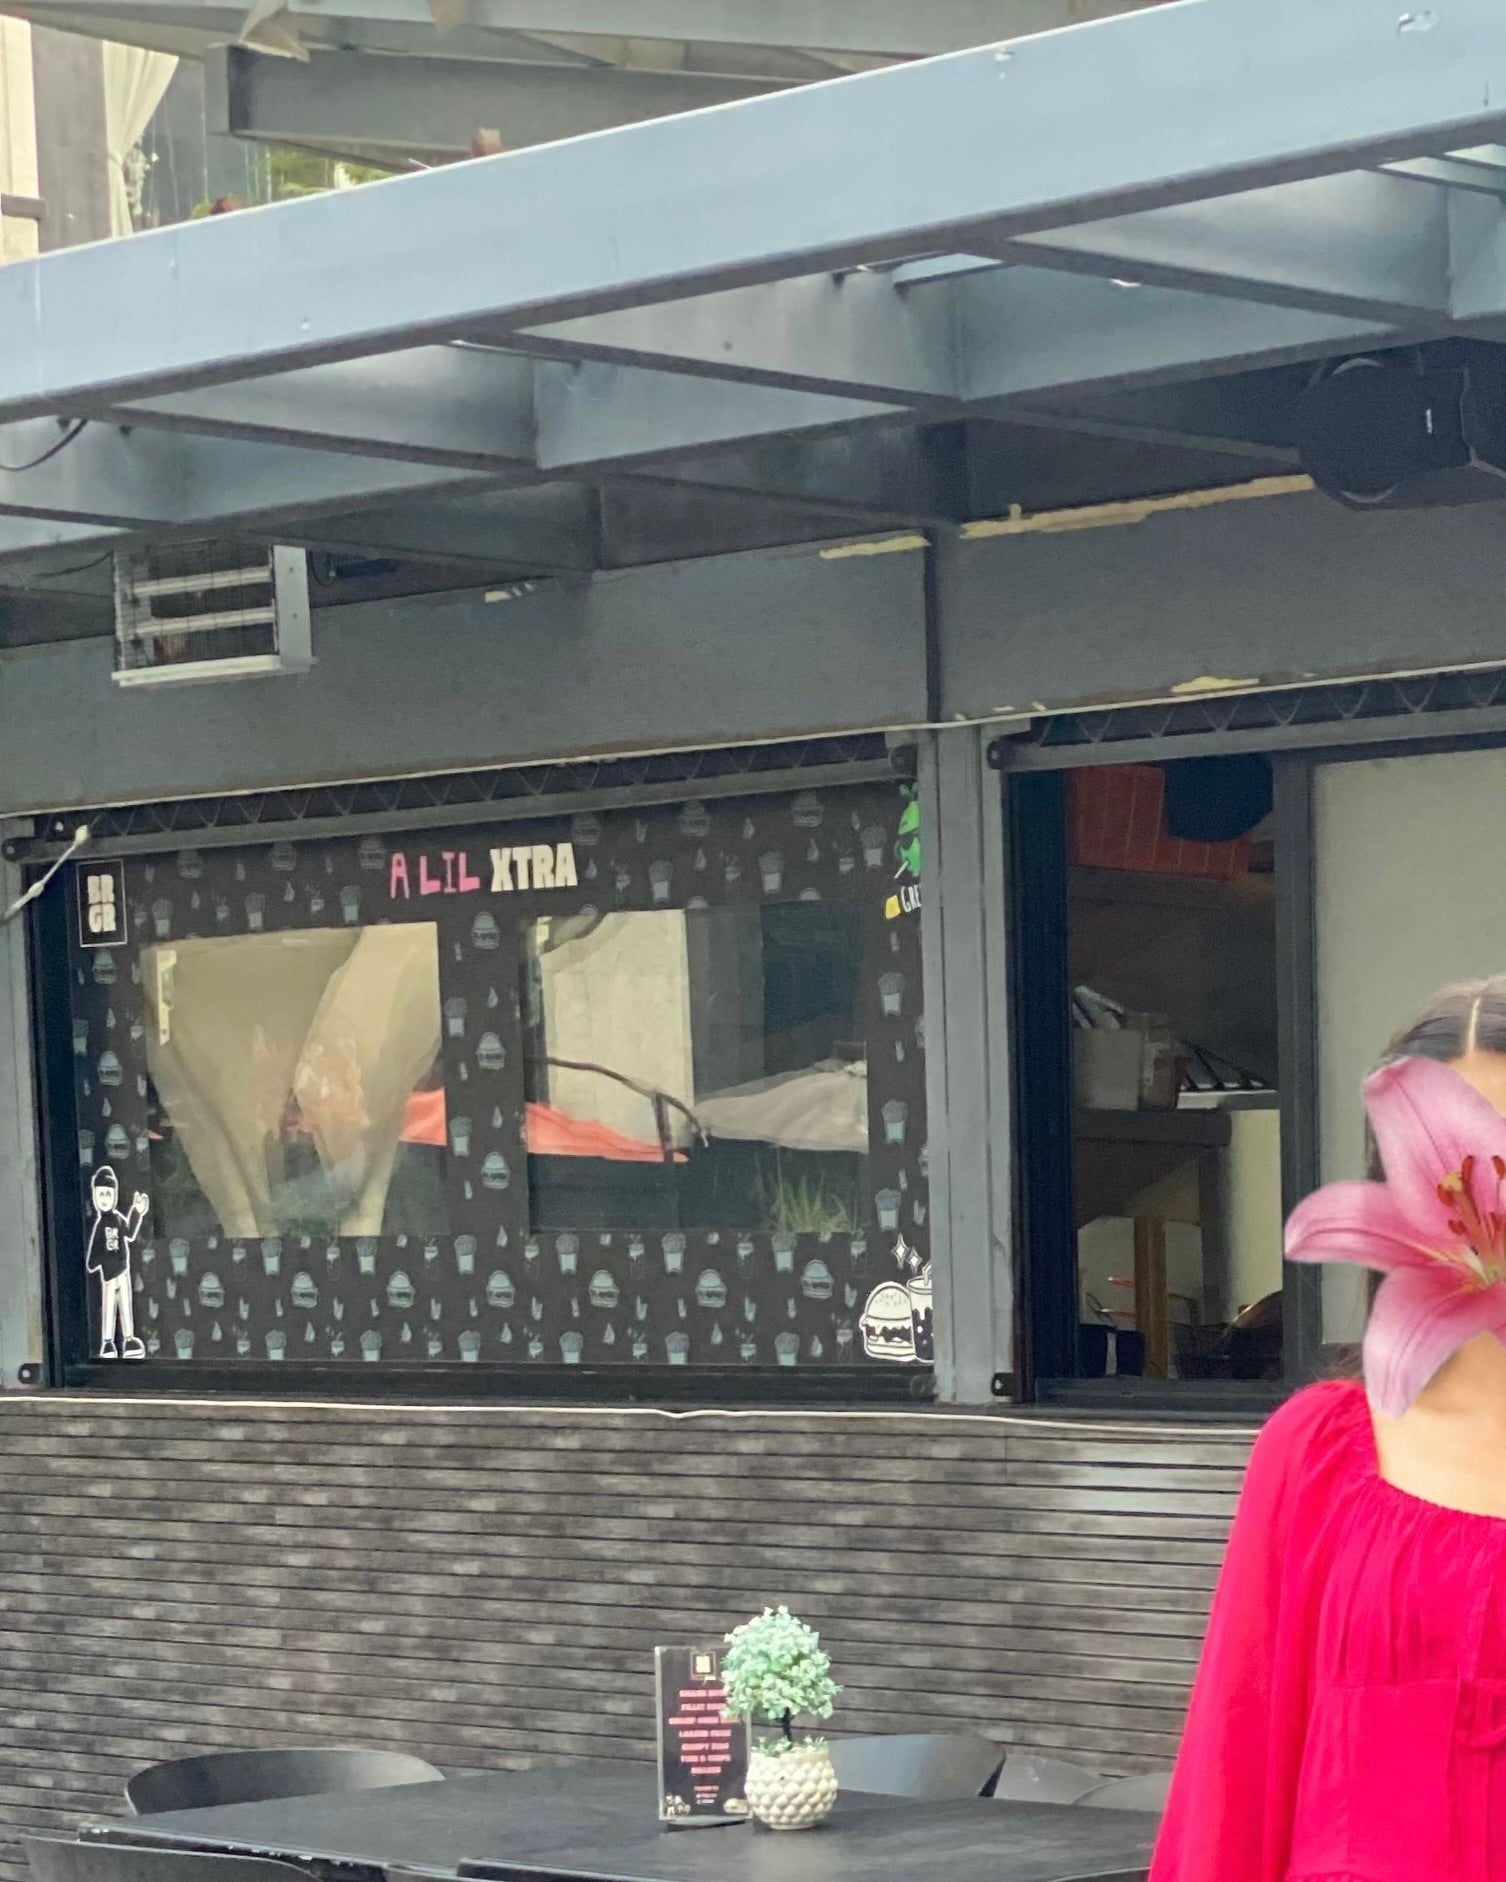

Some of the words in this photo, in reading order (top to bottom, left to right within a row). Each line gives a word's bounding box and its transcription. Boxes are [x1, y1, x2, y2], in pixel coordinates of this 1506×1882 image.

[391, 852, 410, 899] A
[418, 850, 481, 896] LIL
[490, 842, 578, 892] XTRA
